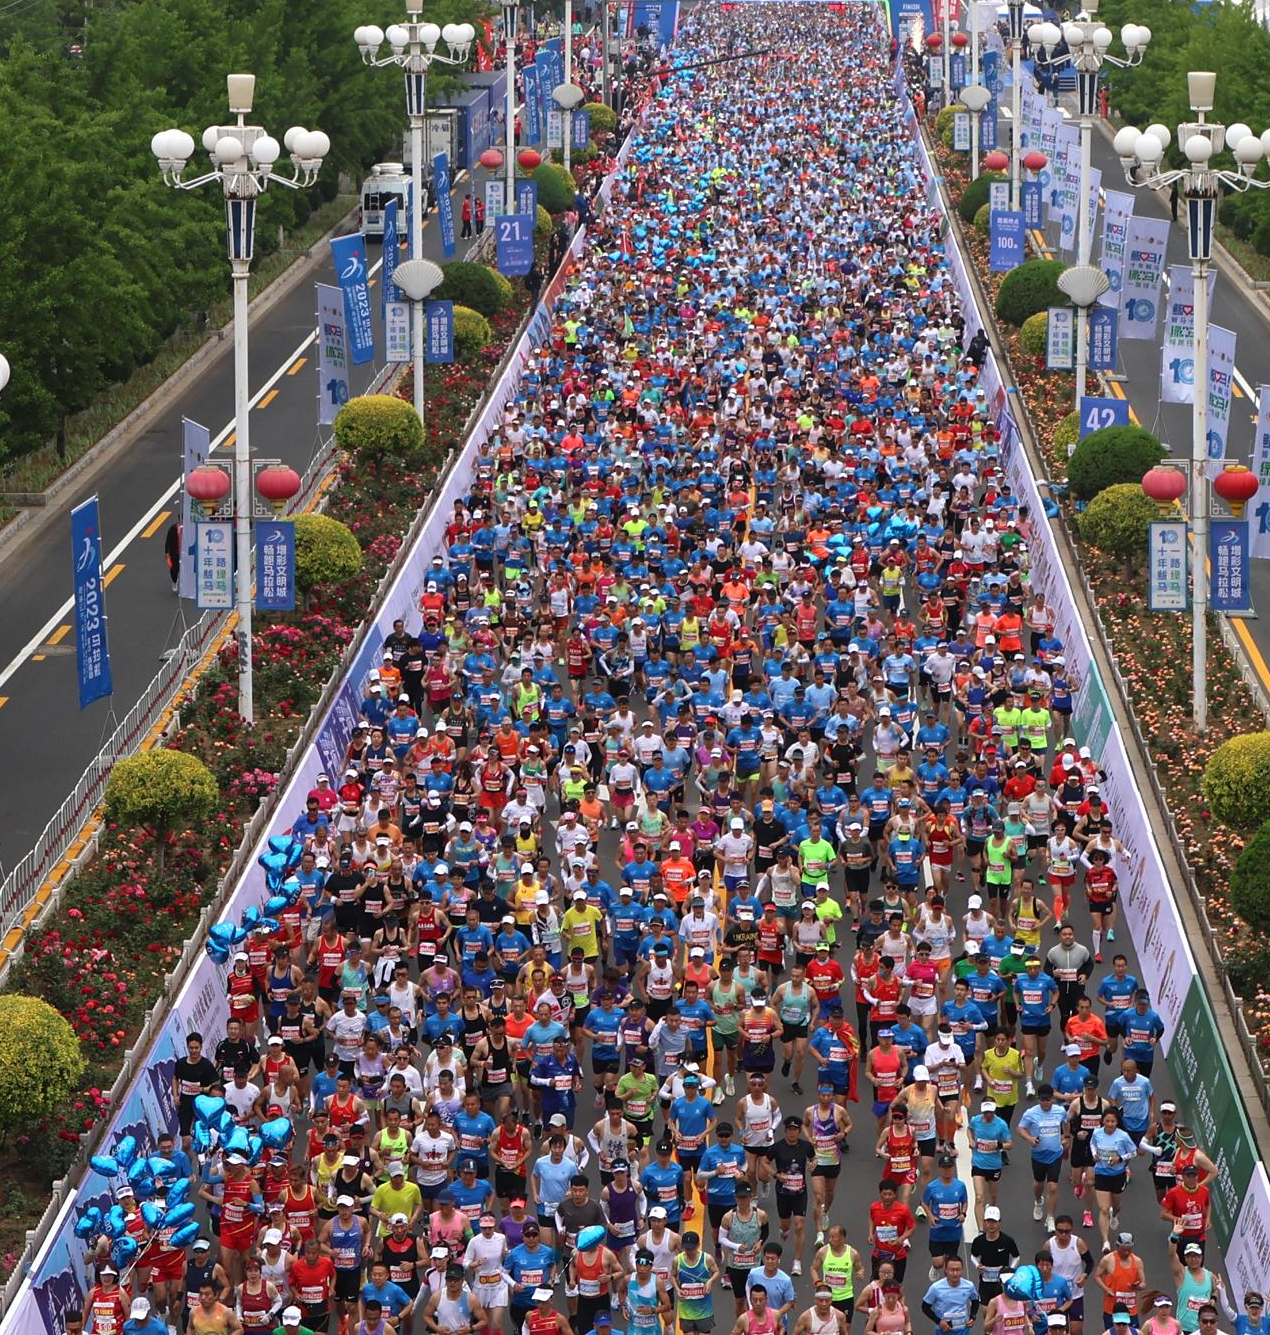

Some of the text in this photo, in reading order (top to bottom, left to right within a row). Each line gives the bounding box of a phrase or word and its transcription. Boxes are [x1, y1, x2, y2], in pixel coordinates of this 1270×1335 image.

[501, 221, 521, 241] 21
[355, 283, 370, 317] 2023
[1086, 407, 1115, 431] 42
[86, 577, 100, 632] 2023
